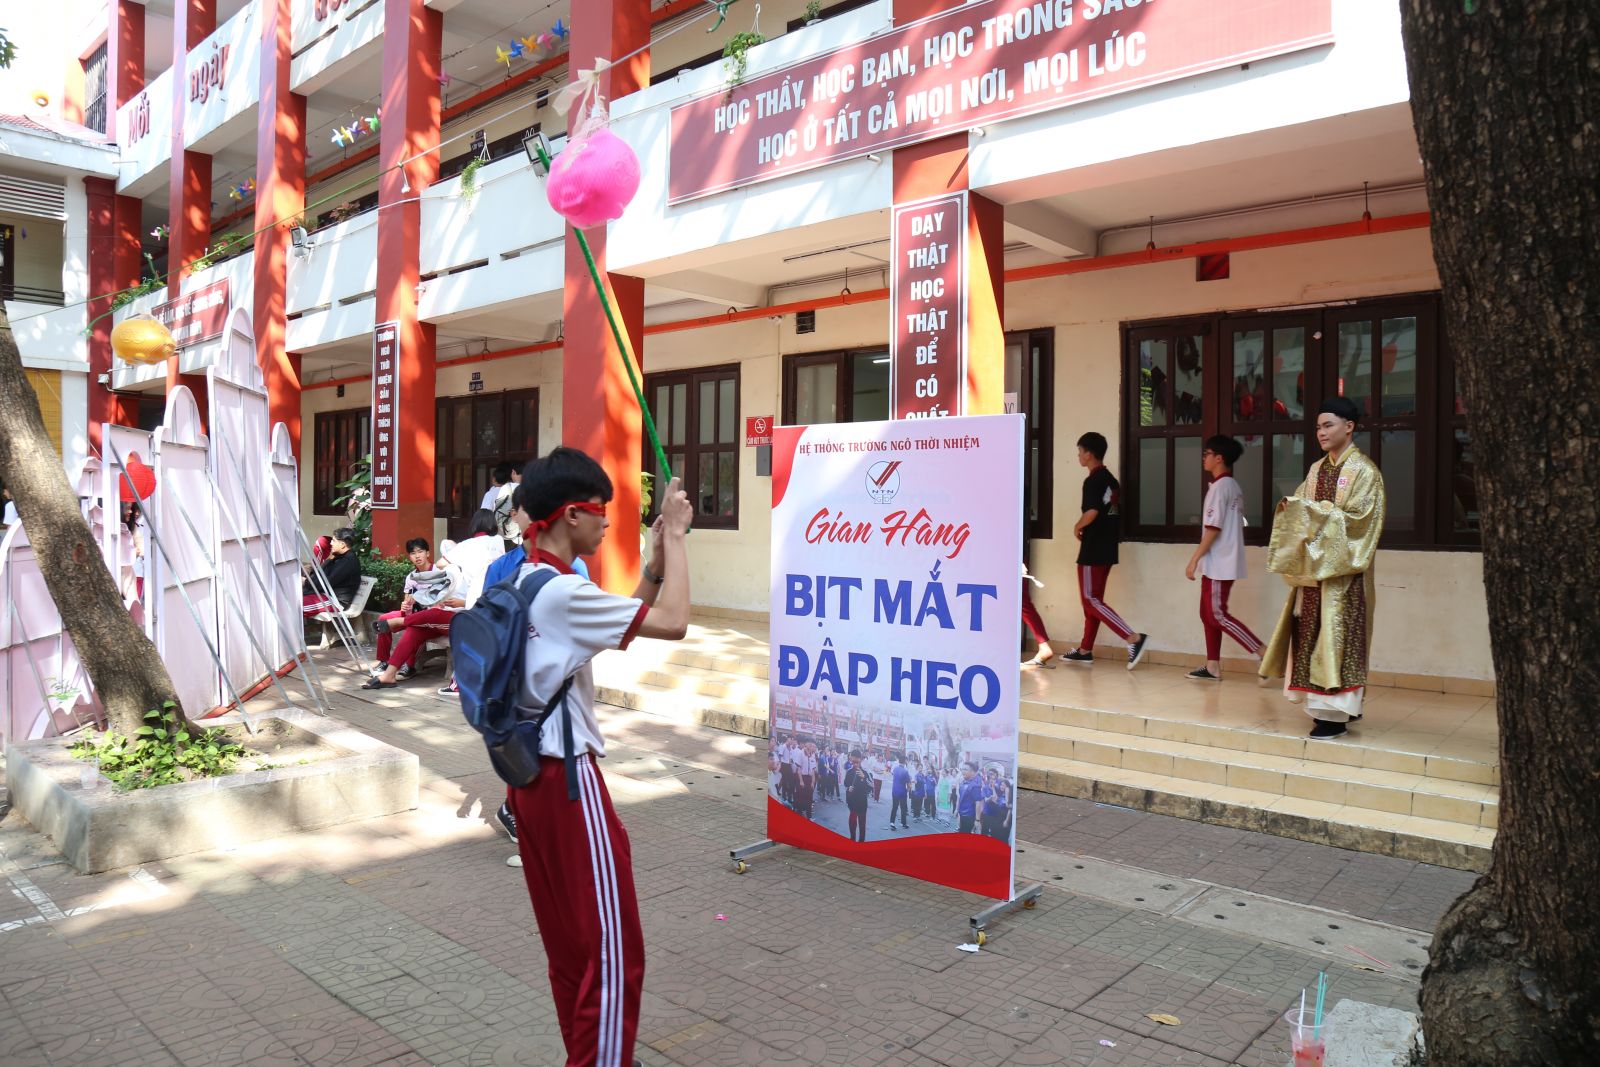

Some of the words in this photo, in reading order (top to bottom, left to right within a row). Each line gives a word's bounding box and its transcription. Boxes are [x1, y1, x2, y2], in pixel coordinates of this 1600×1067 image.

[190, 41, 231, 105] ngày
[714, 98, 750, 135] HỌC
[755, 75, 806, 120] THẦY,
[812, 64, 855, 104] HỌC
[862, 45, 916, 88] BẠN,
[924, 26, 974, 69] HỌC
[981, 0, 1073, 51] TRONG
[758, 129, 798, 166] HỌC
[803, 114, 819, 151] Ở
[823, 103, 861, 147] TẤT
[867, 91, 898, 134] CẢ
[905, 83, 953, 125] MỌI
[960, 68, 1015, 111] NƠI,
[1023, 49, 1079, 94] MỌI
[1088, 29, 1146, 78] LÚC
[911, 211, 945, 238] DẠY
[906, 241, 949, 270] THẬT
[910, 277, 945, 303] HỌC
[906, 307, 948, 336] THẬT
[915, 336, 939, 366] ĐỂ
[915, 373, 938, 398] CÓ
[799, 441, 811, 457] HỆ
[814, 438, 845, 454] THỐNG
[848, 439, 887, 453] TRƯỜNG
[890, 438, 912, 451] NGÔ
[915, 436, 940, 450] THỜI
[943, 435, 980, 451] NHIỆM
[805, 507, 874, 545] Gian
[879, 507, 971, 560] Hàng
[785, 573, 863, 628] BỊT
[873, 558, 998, 632] MẮT
[778, 637, 879, 701] ĐẬP
[890, 656, 1001, 715] HEO
